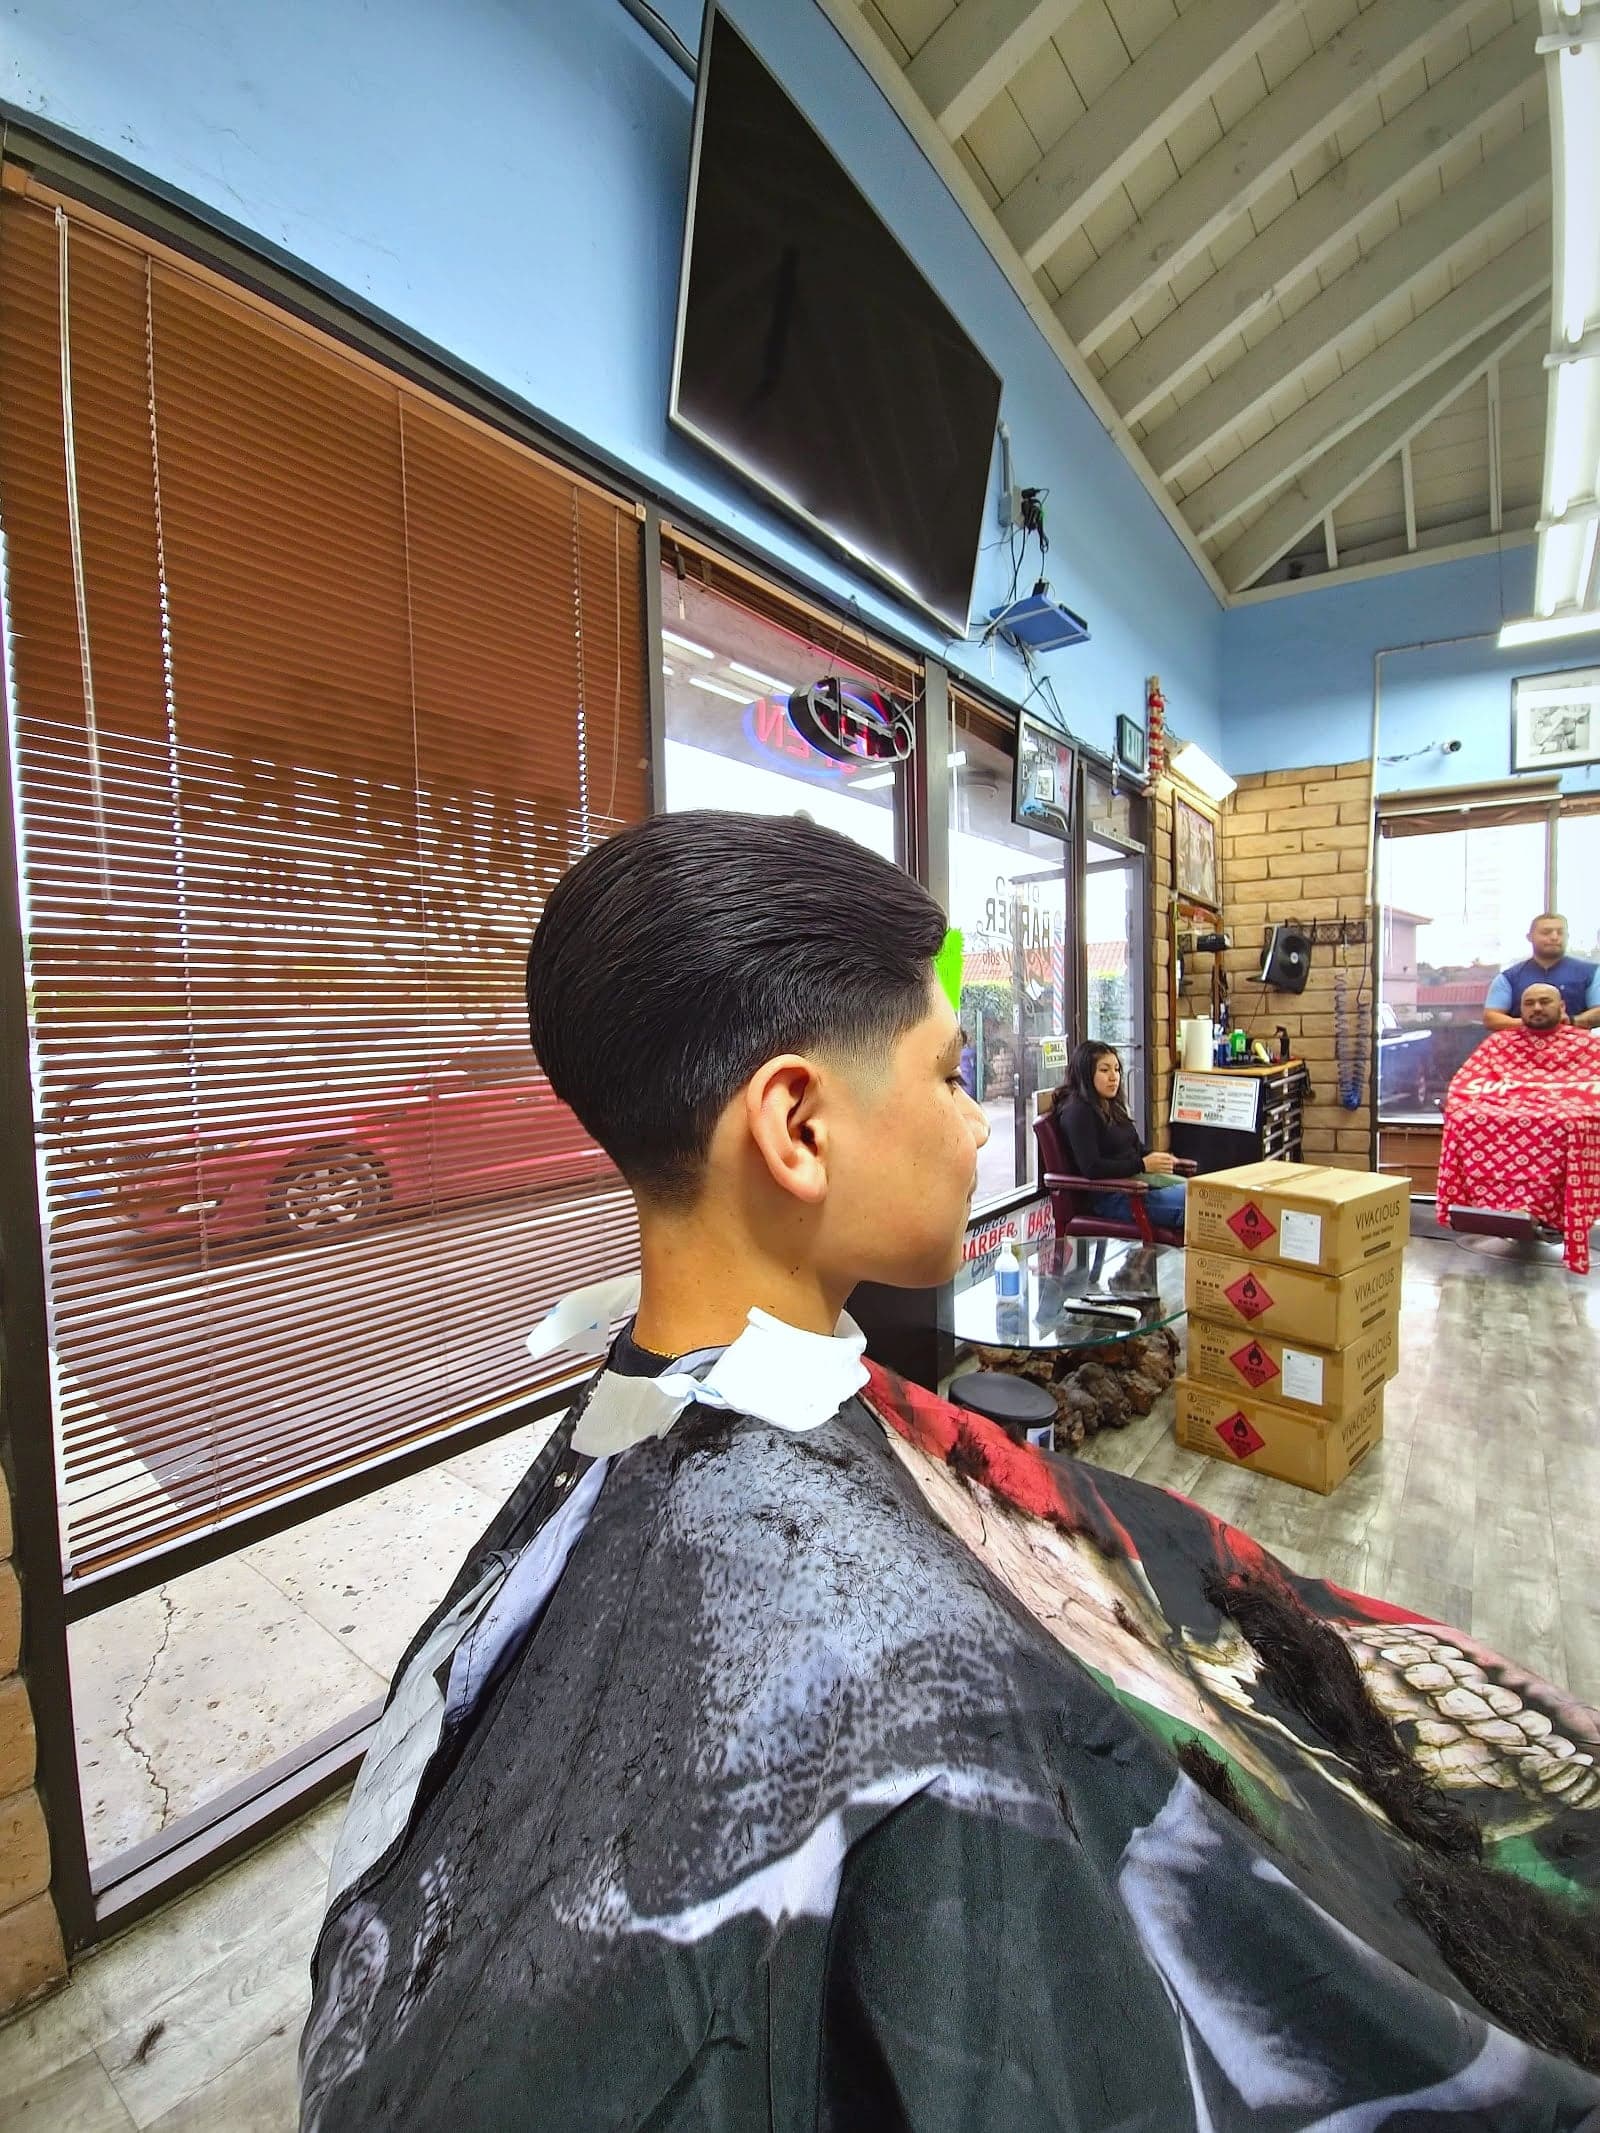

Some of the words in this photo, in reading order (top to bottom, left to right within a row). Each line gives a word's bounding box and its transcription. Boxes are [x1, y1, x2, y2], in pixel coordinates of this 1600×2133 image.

[972, 1215, 1007, 1238] DIEGO
[1355, 1200, 1400, 1231] VIVACIOUS
[1354, 1267, 1395, 1303] VIVACIOUS
[1356, 1331, 1393, 1371] VIVACIOUS
[1341, 1398, 1377, 1442] VIVACIOUS
